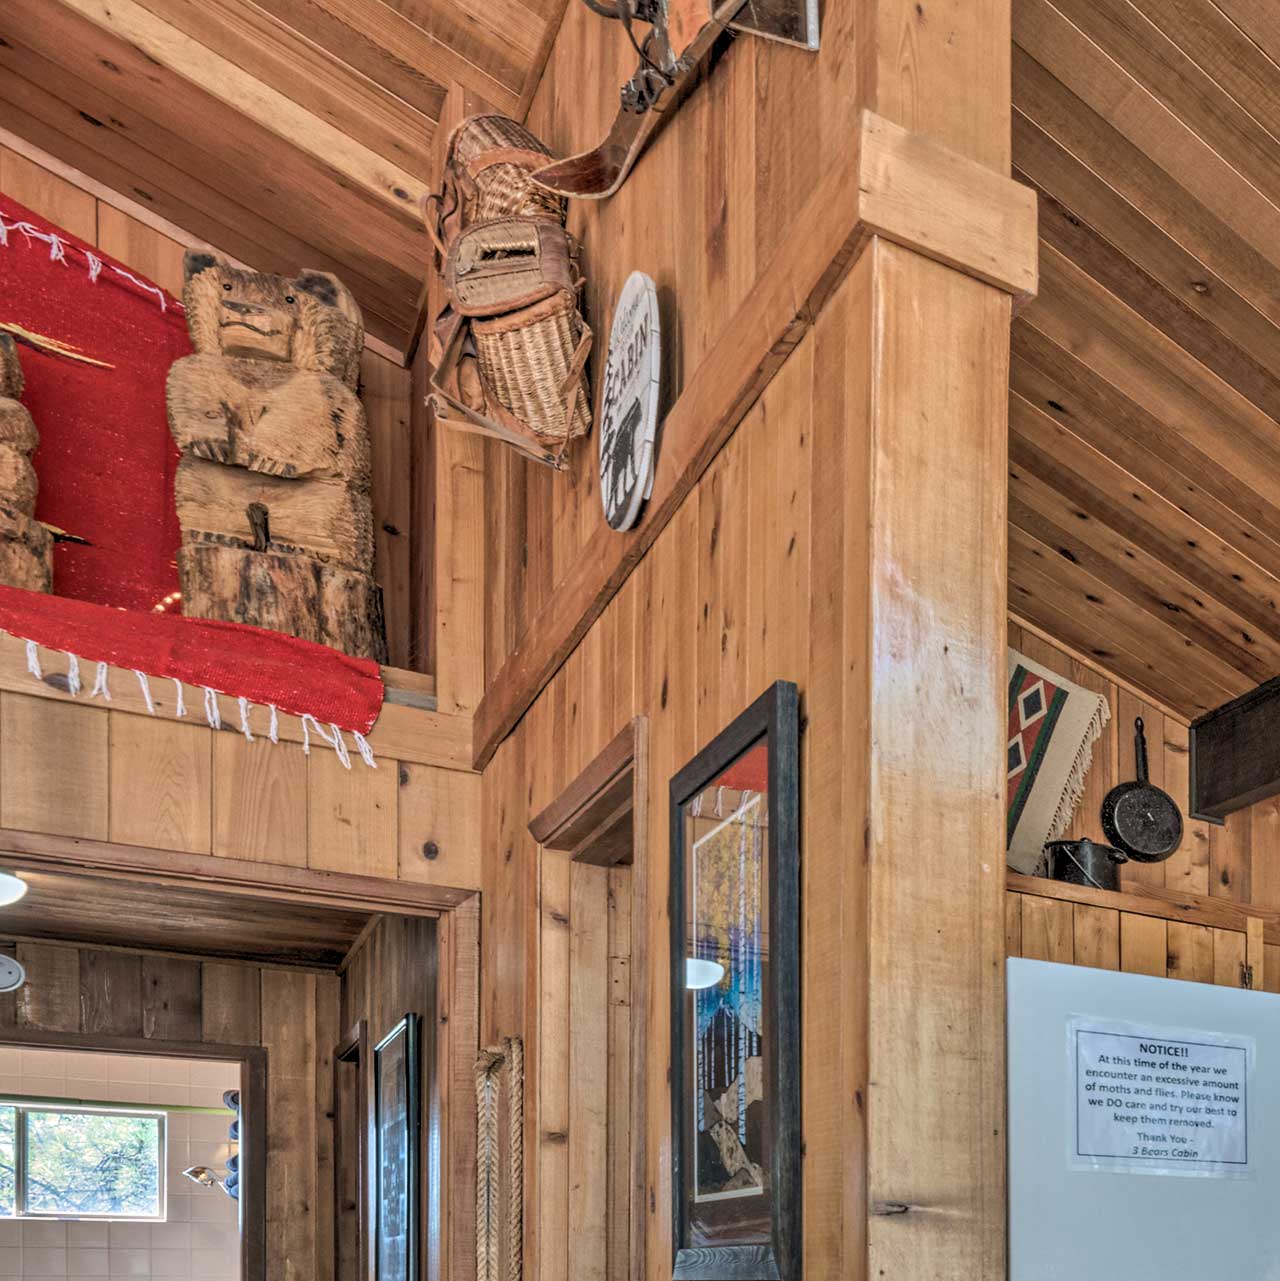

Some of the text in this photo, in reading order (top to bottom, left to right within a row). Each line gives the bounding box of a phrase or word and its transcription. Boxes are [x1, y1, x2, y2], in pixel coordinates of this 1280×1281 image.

[611, 312, 650, 403] CABIN
[1139, 1043, 1189, 1058] NOTICE!!
[1098, 1055, 1227, 1075] At this time of the year we
[1085, 1068, 1239, 1090] encounter an excessive amount
[1085, 1082, 1097, 1091] of
[1099, 1084, 1131, 1095] moths
[1134, 1087, 1152, 1096] and
[1181, 1090, 1211, 1101] Please
[1213, 1093, 1240, 1103] know
[1088, 1098, 1237, 1117] we DO care and try our best to
[1113, 1113, 1214, 1129] keep them removed.
[1137, 1132, 1167, 1144] Thank
[1169, 1134, 1187, 1144] You
[1132, 1146, 1199, 1158] 3 Bears Cabin
